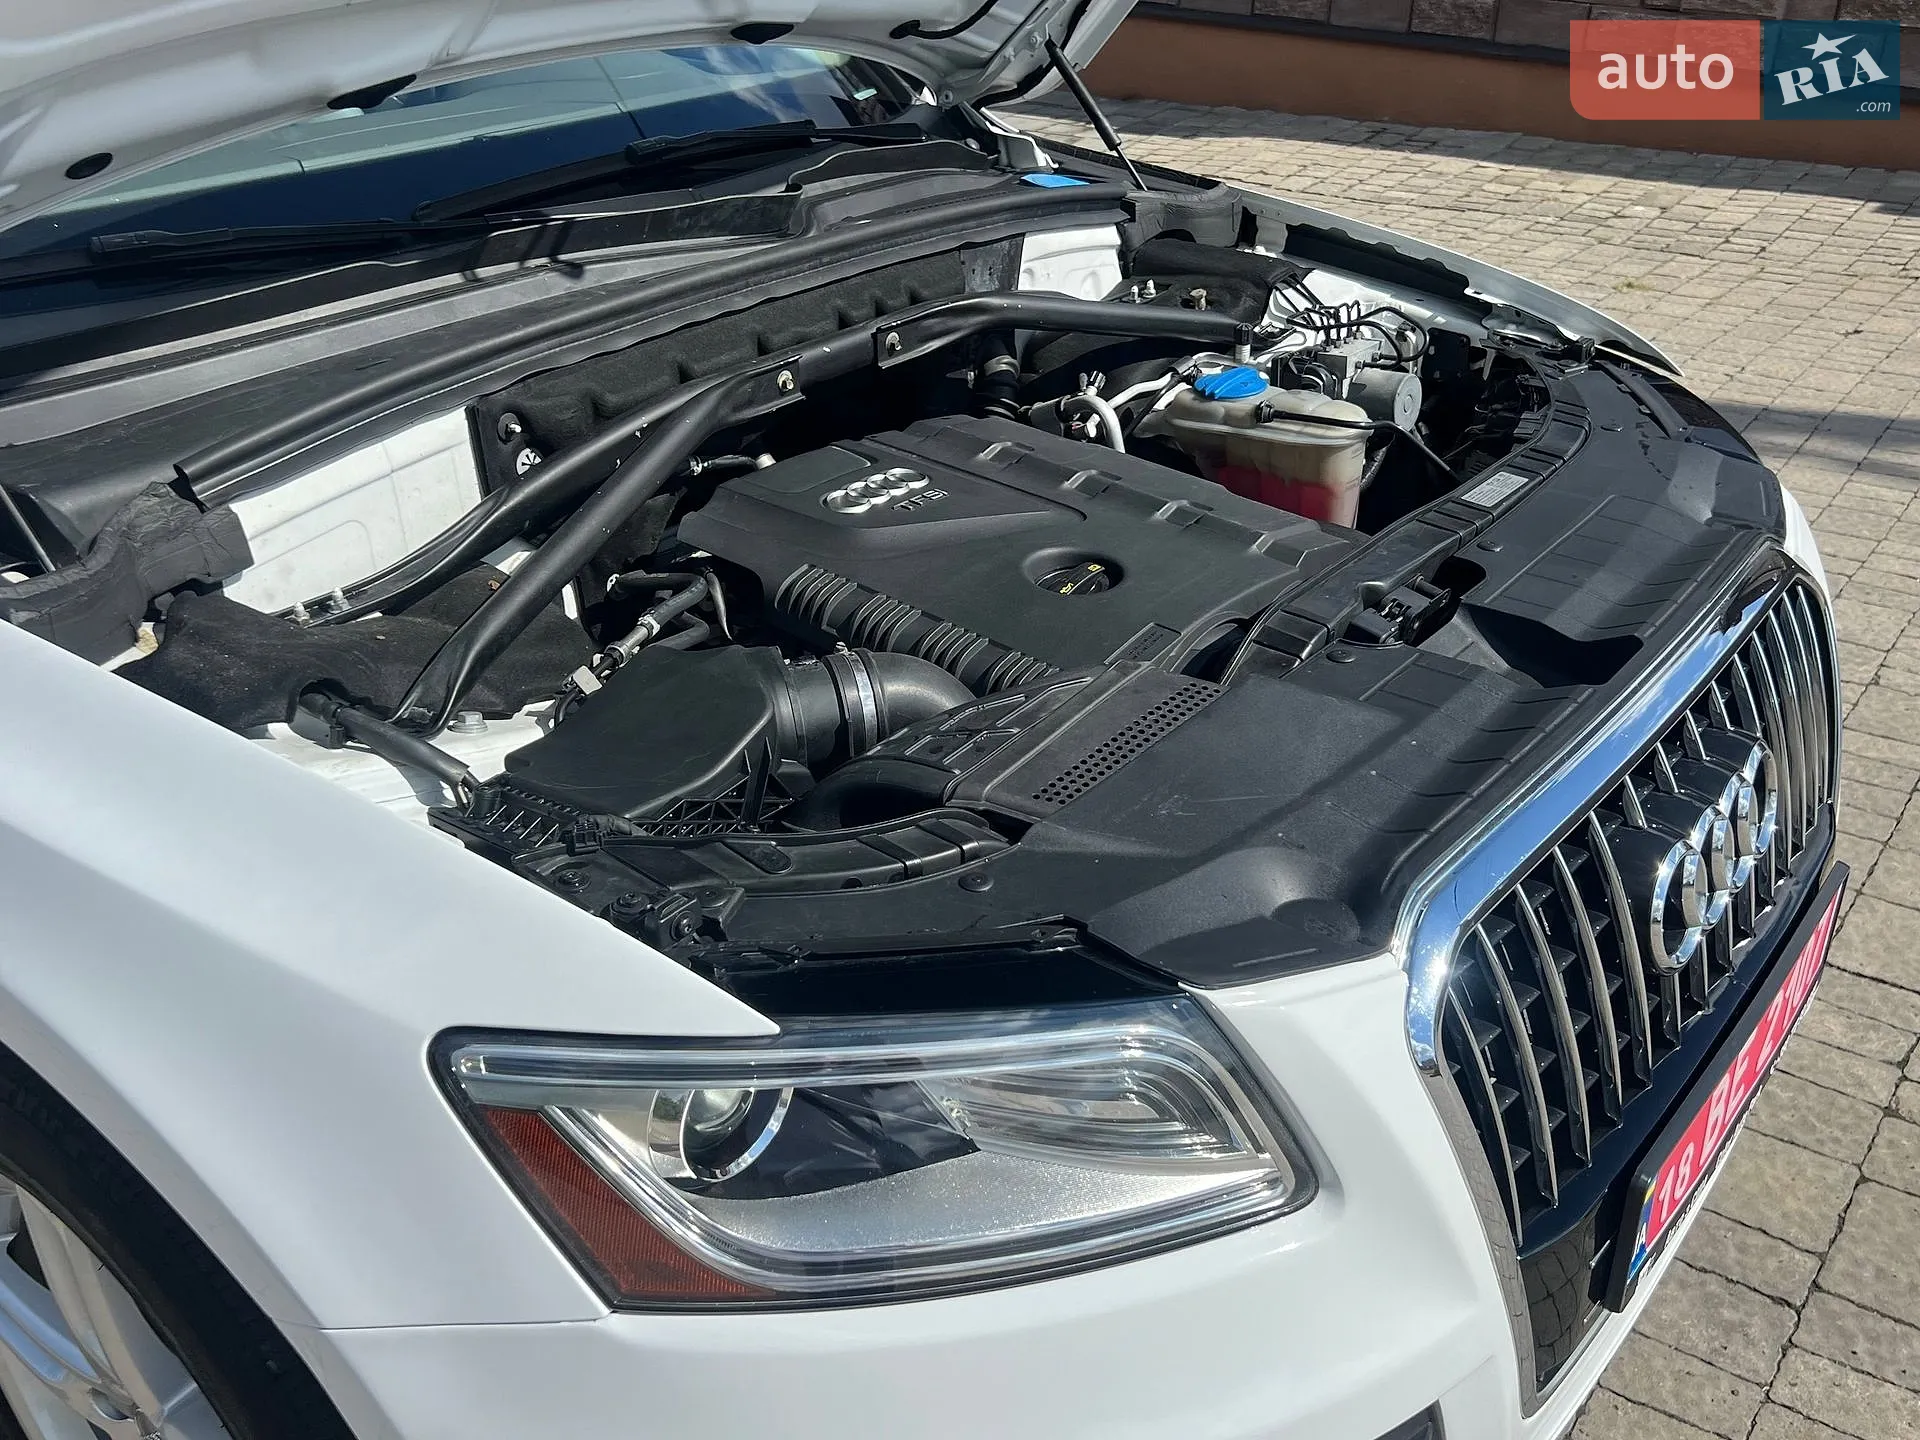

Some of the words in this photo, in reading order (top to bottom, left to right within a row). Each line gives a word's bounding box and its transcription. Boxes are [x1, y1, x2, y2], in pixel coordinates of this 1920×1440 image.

[892, 488, 949, 511] TFSI
[1659, 1142, 1695, 1223] 18
[1699, 1027, 1758, 1168] BE
